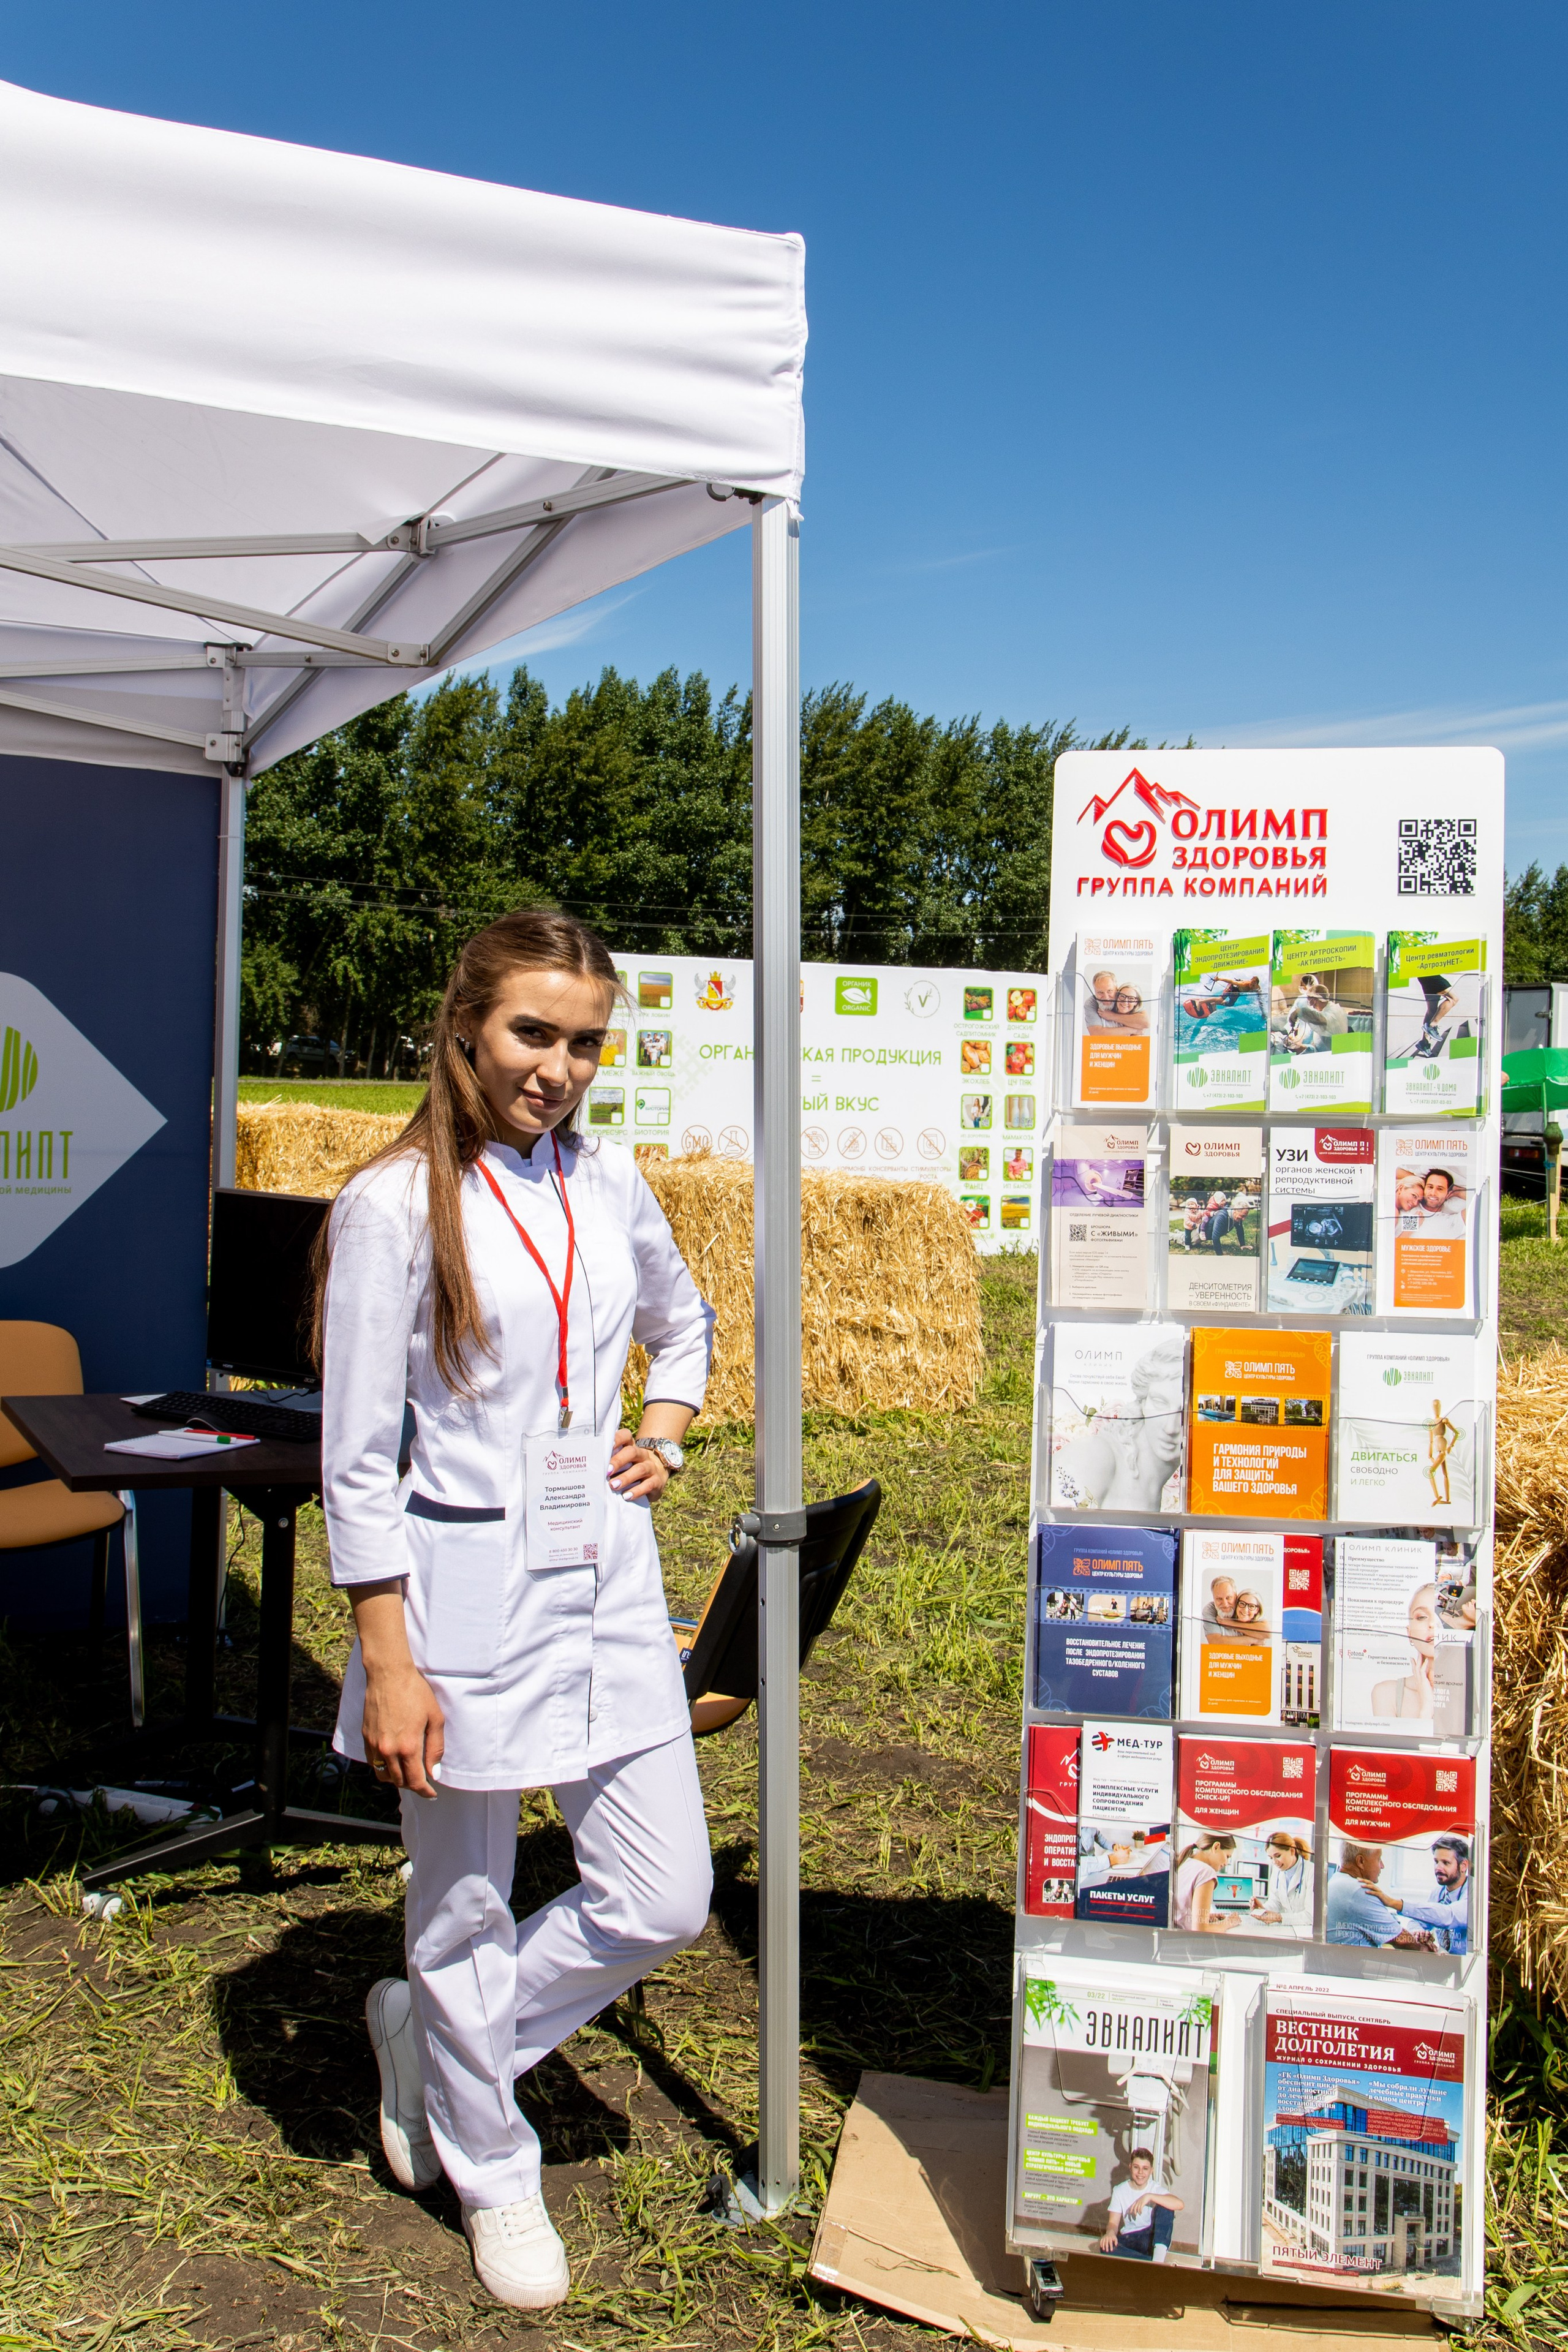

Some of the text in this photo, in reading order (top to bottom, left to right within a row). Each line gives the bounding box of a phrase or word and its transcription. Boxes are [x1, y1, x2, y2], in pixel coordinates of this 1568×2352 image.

[1171, 809, 1328, 840] ОЛИМП
[1172, 847, 1327, 872] ЗДОРОВЬЯ
[1077, 874, 1327, 897] ГРУППА КОМПАНИЙ
[1103, 939, 1153, 949] ОЛИМП ПЯТЬ
[1195, 948, 1264, 963] ЭНДОПРОТЕЗИРОВАНИЯ
[1287, 945, 1356, 960] ЦЕНТР АРТРОСКОПИИ
[1428, 949, 1474, 960] ревматологии
[1210, 959, 1248, 969] «ДВИЖЕНИЕ»
[1297, 956, 1345, 967] «АКТИВНОСТЬ»
[1417, 958, 1463, 969] «АртрозуНЕТ»
[842, 1049, 941, 1066] ПРОДУКЦИЯ
[1211, 1070, 1251, 1083] ЭВКАЛИПТ
[1303, 1071, 1344, 1084] ЭВКАЛИПТ
[835, 1097, 880, 1111] ВКУС
[1415, 1140, 1468, 1150] ОЛИМП ПЯТЬ
[1276, 1149, 1308, 1161] УЗИ
[1075, 1350, 1121, 1360] ОЛИМП
[1244, 1362, 1295, 1374] ОЛИМП ПЯТЬ
[1213, 1443, 1306, 1459] ГАРМОНИЯ ПРИРОДЫ
[1351, 1452, 1417, 1462] ДВИГАТЬСЯ
[1213, 1456, 1279, 1469] И ТЕХНОЛОГИЙ
[1213, 1469, 1273, 1482] ДЛЯ ЗАЩИТЫ
[1213, 1481, 1297, 1494] ВАШЕГО ЗДОРОВЬЯ
[540, 1502, 590, 1510] Владимировна
[1222, 1542, 1274, 1555] ОЛИМП ПЯТЬ
[1092, 1559, 1143, 1572] ОЛИМП ПЯТЬ
[1066, 1638, 1121, 1648] ВОССТАНОВИТЕЛЬНОЕ
[1085, 1649, 1145, 1659] ЭНДОПРОТЕЗИРОВАНИЯ
[1066, 1658, 1145, 1669] ТАЗОБЕДРЕННОГО/КОЛЕННОГО
[1092, 1669, 1118, 1678] СУСТАВОВ
[1117, 1738, 1163, 1749] МЕД-ТУР
[1346, 1799, 1457, 1812] КОМПЛЕКСНОГО ОБСЛЕДОВАНИЯ
[1090, 1890, 1155, 1903] ПАКЕТЫ УСЛУГ
[1276, 2009, 1325, 2018] СПЕЦИАЛЬНЫЙ
[1086, 2011, 1204, 2058] ЭВКАЛИПТ
[1276, 2020, 1359, 2040] ВЕСТНИК
[1275, 2037, 1395, 2061] ДОЛГОЛЕТИЯ
[1315, 2059, 1361, 2068] СОХРАНЕНИИ
[1273, 2246, 1317, 2260] ПЯТЫЙ
[1322, 2253, 1382, 2269] ЭЛЕМЕНТ
